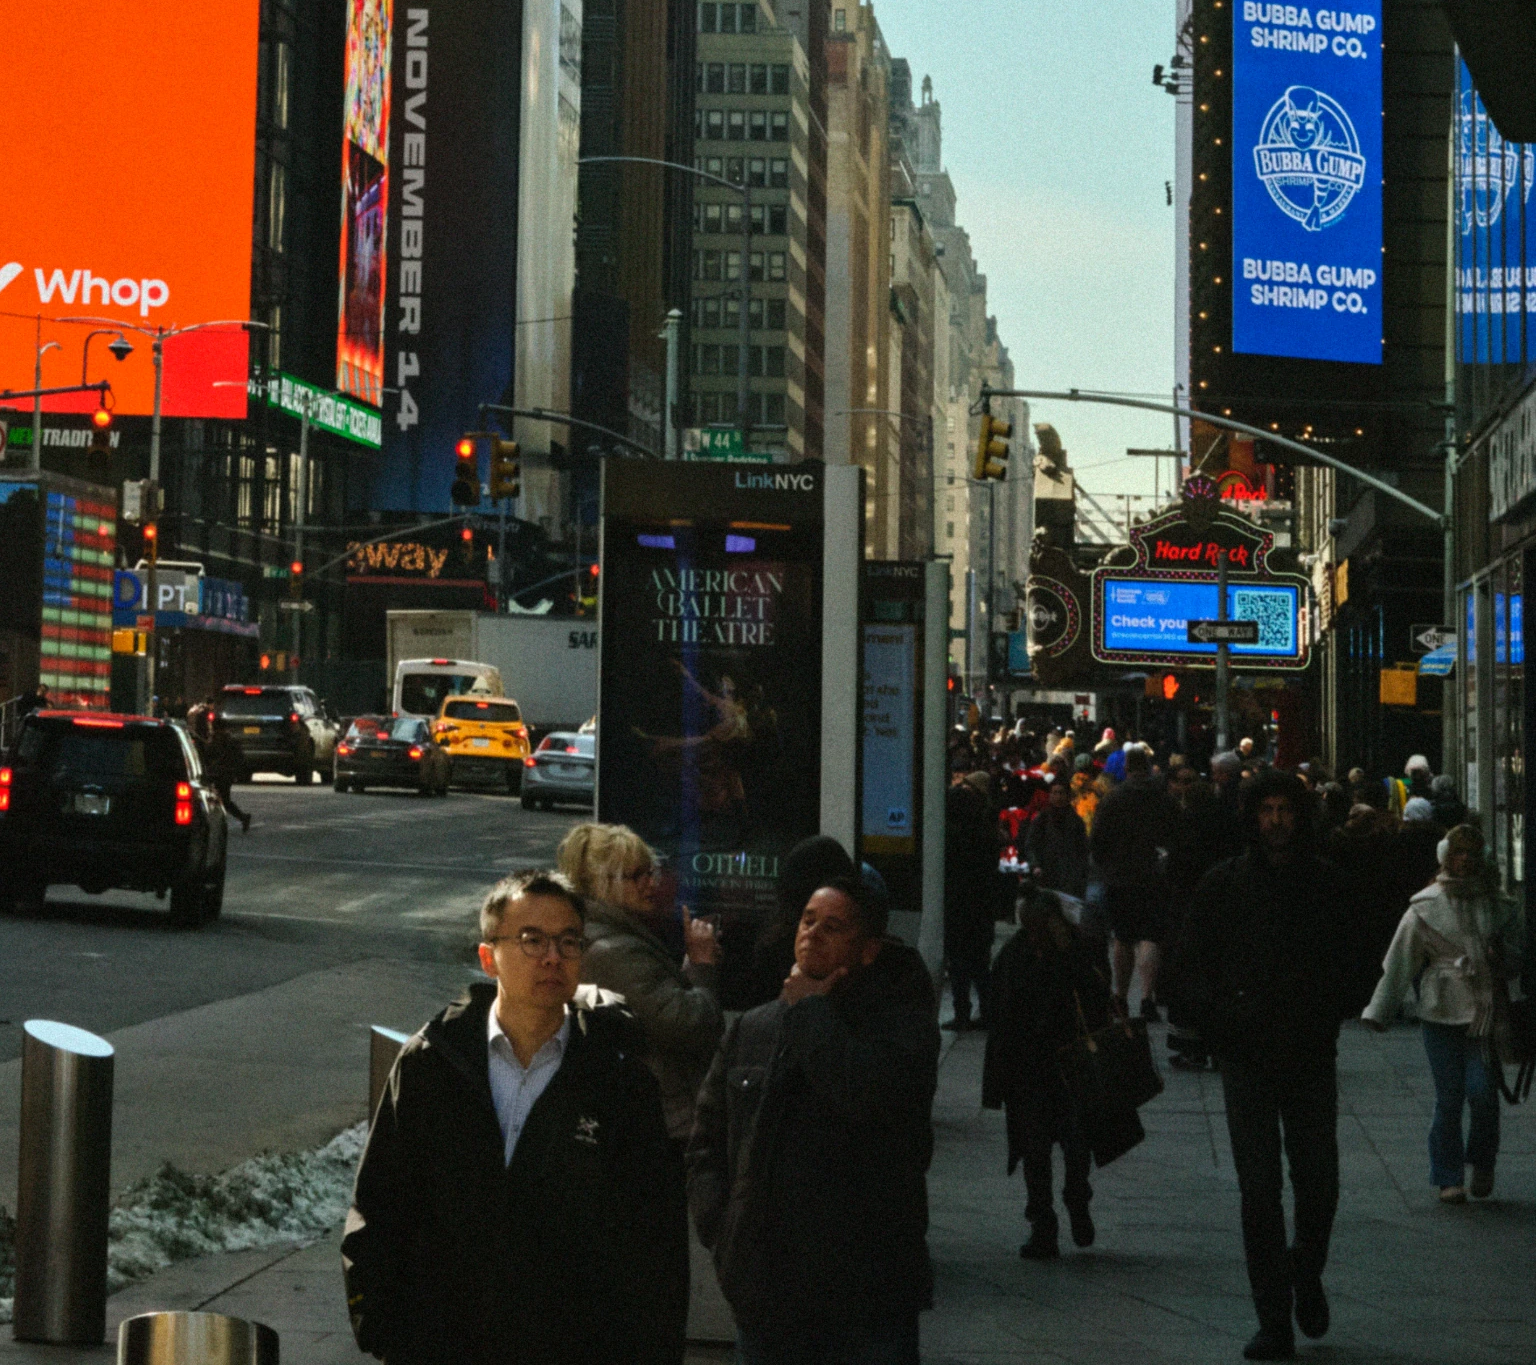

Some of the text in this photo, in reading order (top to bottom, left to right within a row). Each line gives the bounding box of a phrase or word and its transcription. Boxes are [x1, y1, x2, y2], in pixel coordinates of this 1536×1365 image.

[1243, 1, 1377, 36] BUBBA GUMP
[1250, 26, 1368, 60] SHRIMP CO.
[1260, 149, 1362, 182] BUBBA GUMP
[396, 7, 429, 431] NOVEMBER 14
[1243, 258, 1377, 291] BUBBA GUMP
[34, 267, 170, 316] Whop
[1250, 283, 1368, 316] SHRIMP CO.
[702, 432, 711, 449] W
[714, 432, 731, 449] 44
[735, 472, 814, 491] LinkNYC
[1155, 540, 1249, 567] Hard Rck
[647, 567, 784, 594] AMERICAN
[656, 588, 771, 621] BALLET
[651, 618, 776, 646] THEATRE
[1111, 614, 1188, 633] Check you
